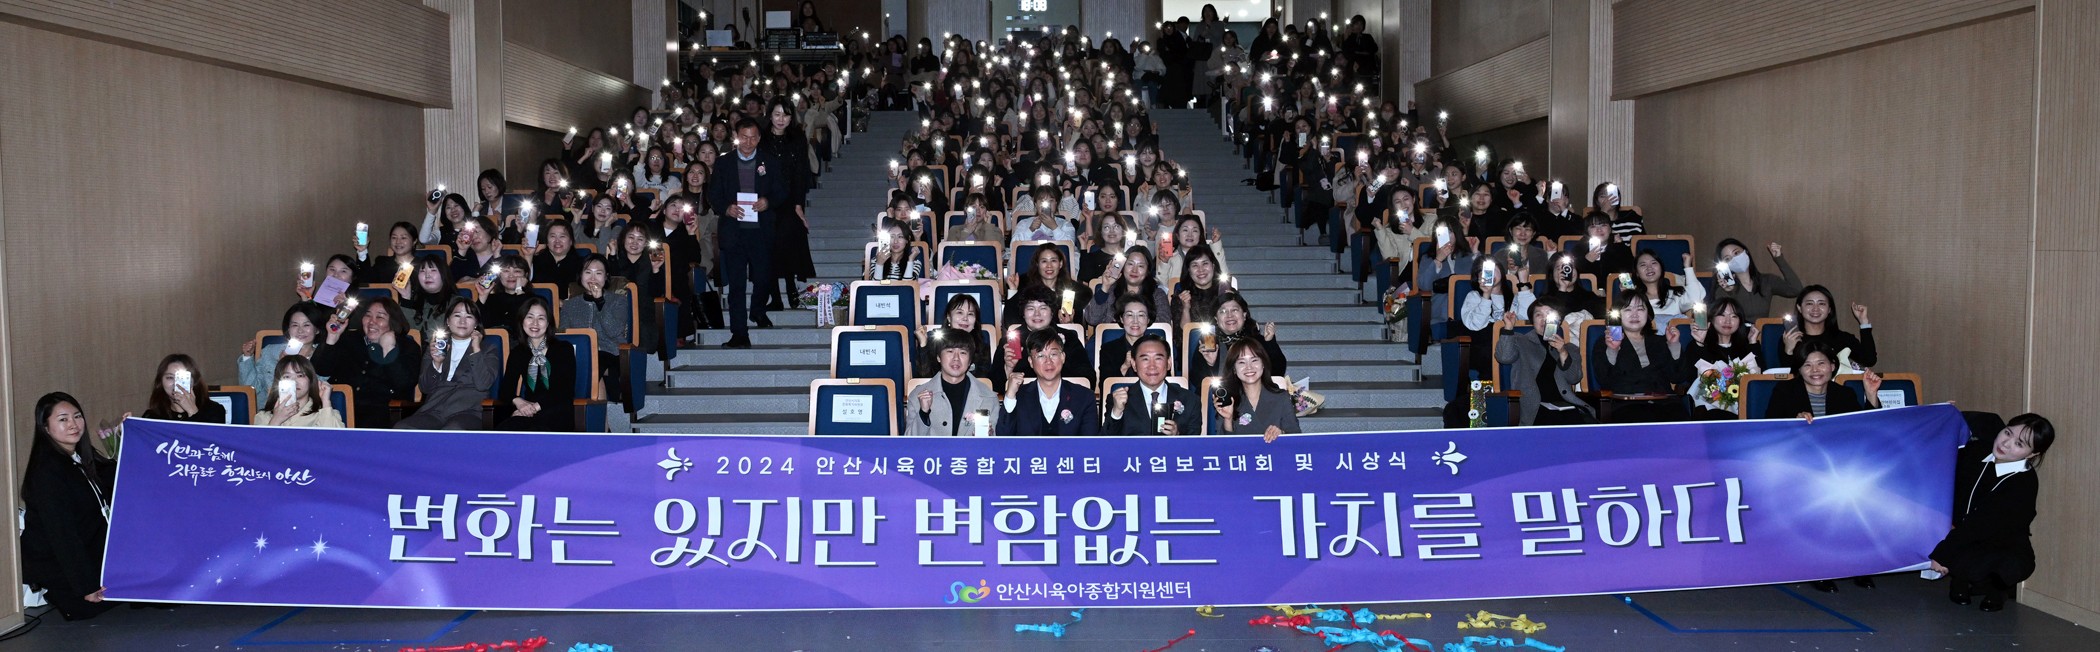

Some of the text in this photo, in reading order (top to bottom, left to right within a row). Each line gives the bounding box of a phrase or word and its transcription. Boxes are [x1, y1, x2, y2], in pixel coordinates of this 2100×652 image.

[156, 439, 204, 464] 시민과
[716, 451, 1407, 475] 2024 안산시육아종합지원센터 사업보고대회 및 시상식
[168, 464, 316, 486] 자유로운 혁신도시 안산
[387, 477, 1750, 568] 변화는 있지만 변함없는 가치를 말하다
[996, 581, 1192, 601] 안산시육아종합지원센터
